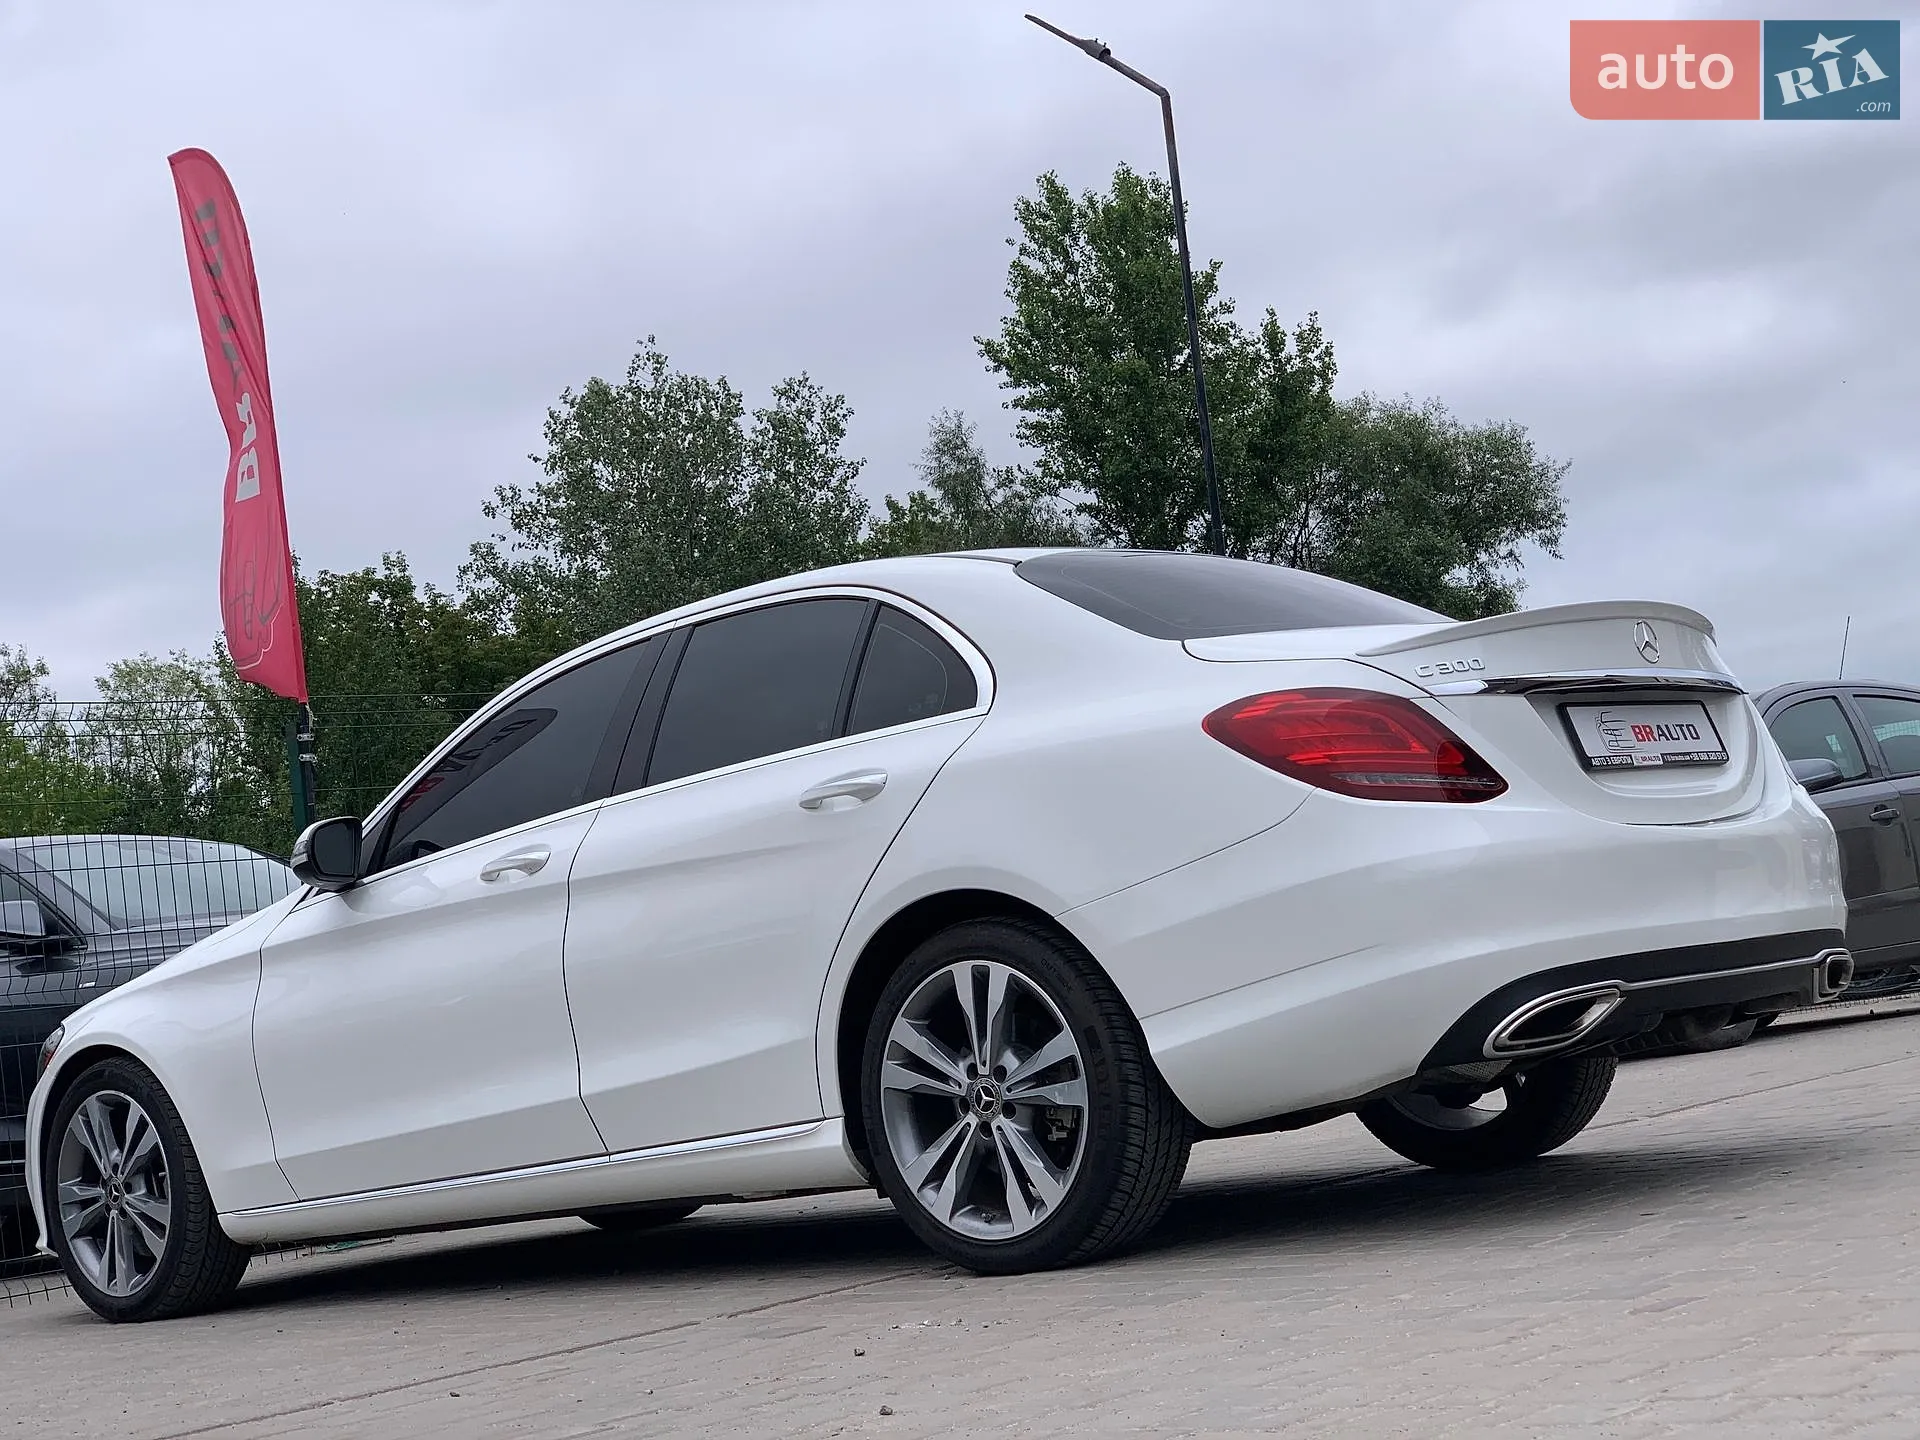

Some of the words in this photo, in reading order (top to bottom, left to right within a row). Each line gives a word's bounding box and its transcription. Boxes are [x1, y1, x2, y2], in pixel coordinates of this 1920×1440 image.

[1415, 664, 1433, 677] C
[1435, 657, 1485, 674] 300
[1630, 724, 1700, 742] BRAUTO
